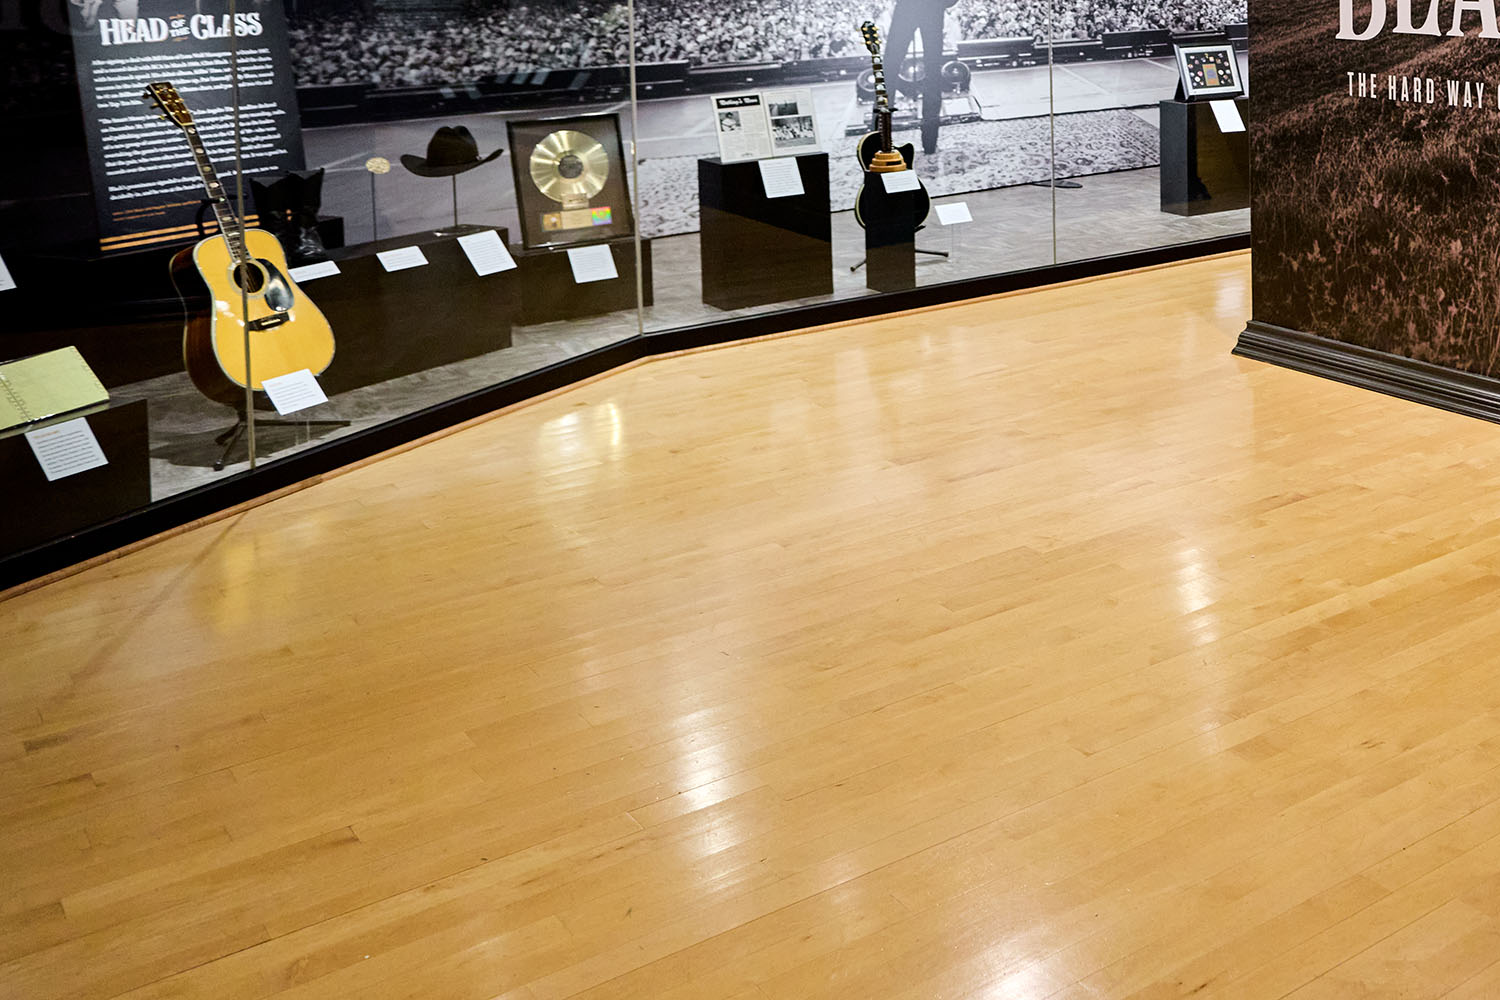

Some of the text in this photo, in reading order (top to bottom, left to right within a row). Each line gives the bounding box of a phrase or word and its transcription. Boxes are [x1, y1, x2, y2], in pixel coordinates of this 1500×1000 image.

[99, 12, 263, 46] HEAD OF THE CLASS
[1347, 72, 1377, 99] THE
[1388, 75, 1435, 104] HARD
[1447, 80, 1485, 110] WAY
